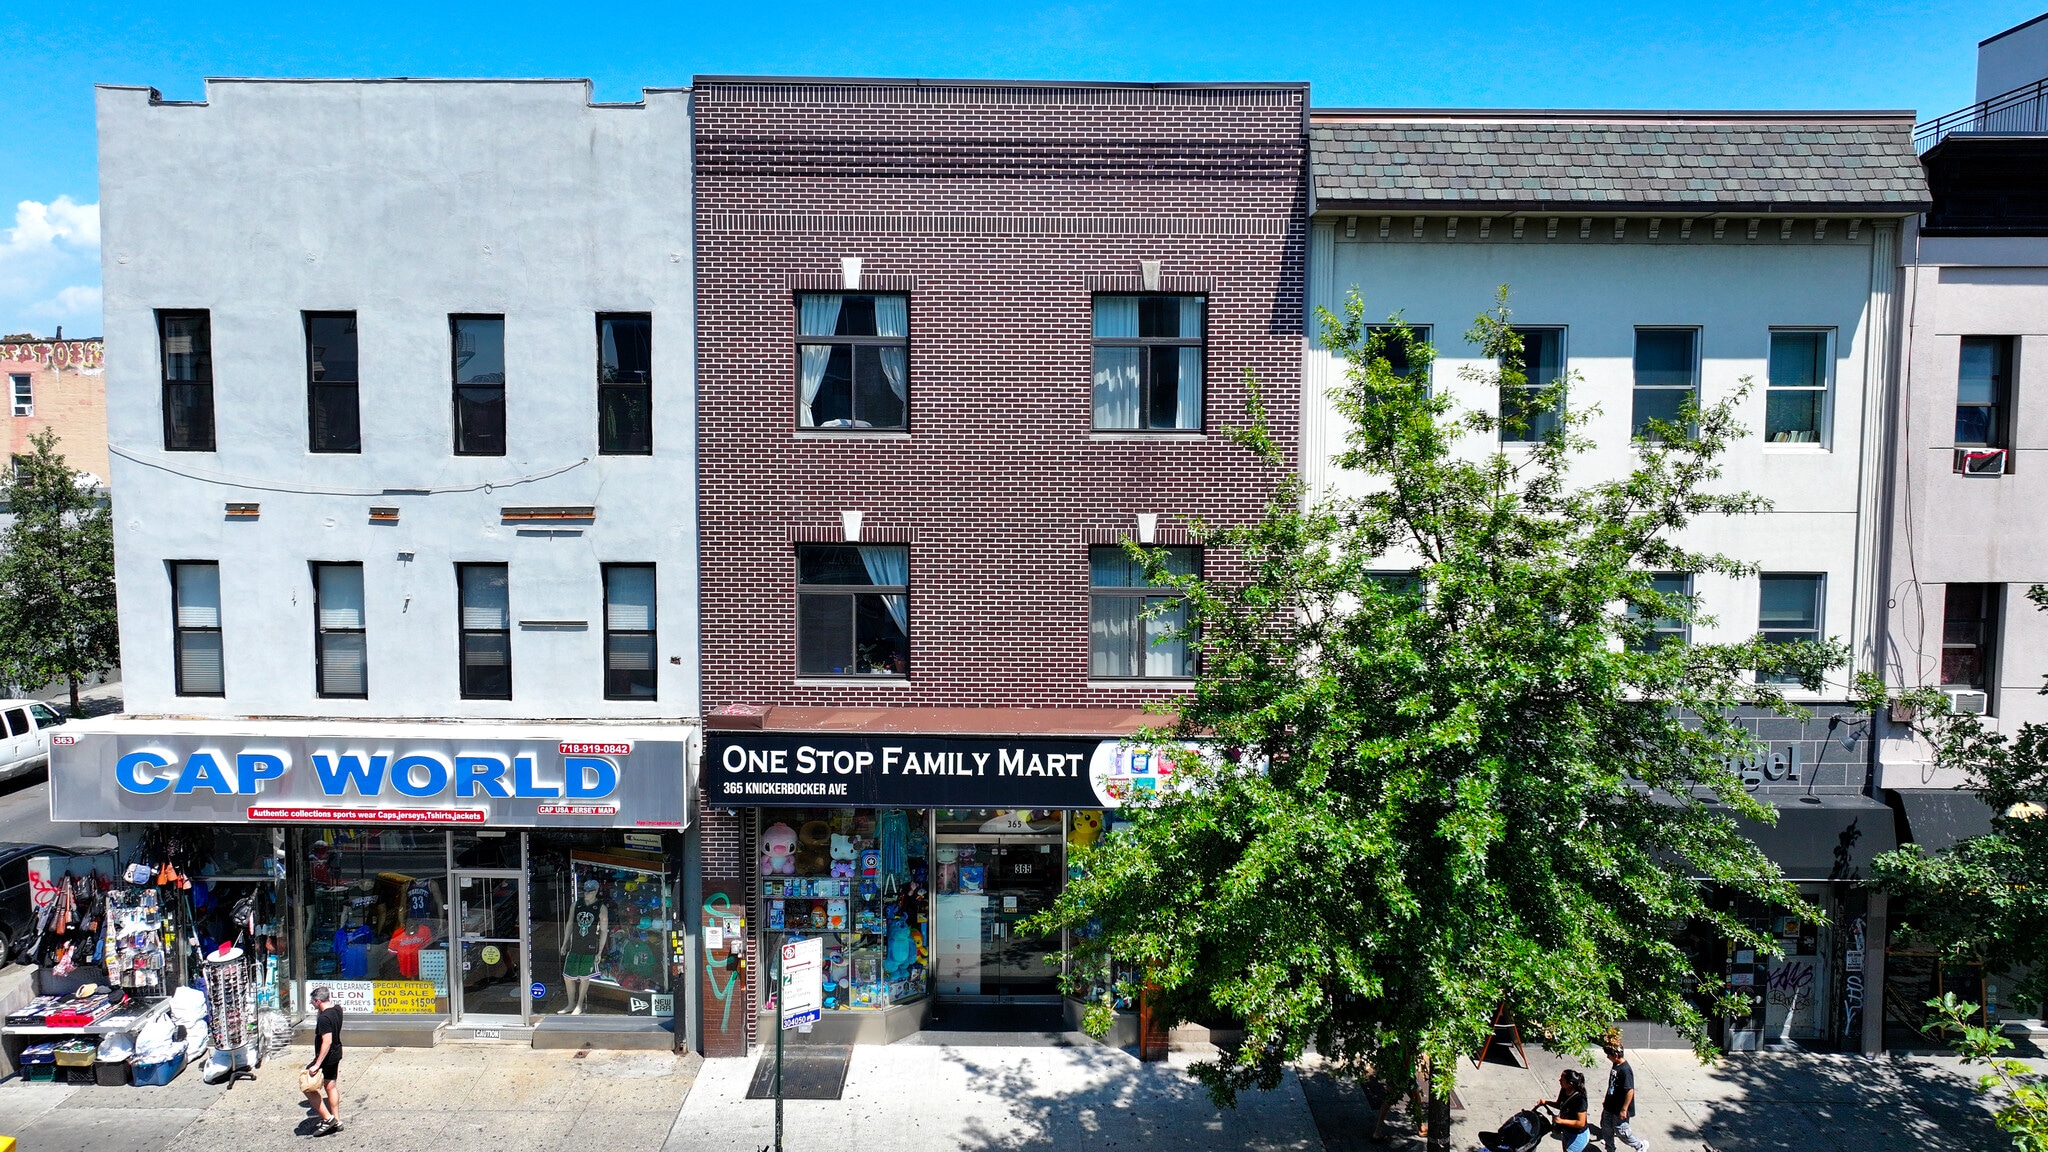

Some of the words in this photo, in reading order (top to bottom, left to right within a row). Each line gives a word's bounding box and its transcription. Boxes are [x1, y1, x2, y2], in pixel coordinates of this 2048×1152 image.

[54, 736, 73, 744] 363
[561, 744, 628, 754] 718-919-0842
[723, 745, 788, 775] ONE
[796, 746, 874, 775] STOP
[882, 746, 991, 777] FAMILY
[998, 749, 1084, 777] MART
[115, 752, 285, 795] CAP
[311, 753, 618, 799] WORLD
[723, 782, 743, 794] 365
[745, 782, 826, 795] KNICKERBOCKER
[828, 783, 848, 796] AVE
[253, 809, 289, 817] Authentic
[291, 809, 331, 818] collections
[333, 811, 356, 820] sports
[540, 806, 554, 814] CAP
[555, 806, 569, 814] USA
[1007, 820, 1022, 828] 365
[1014, 863, 1032, 874] 365
[412, 895, 425, 910] 33
[336, 982, 371, 991] CLEARANCE
[373, 998, 398, 1007] $10.00
[412, 998, 436, 1007] $15.00
[475, 1029, 499, 1038] CAUTION
